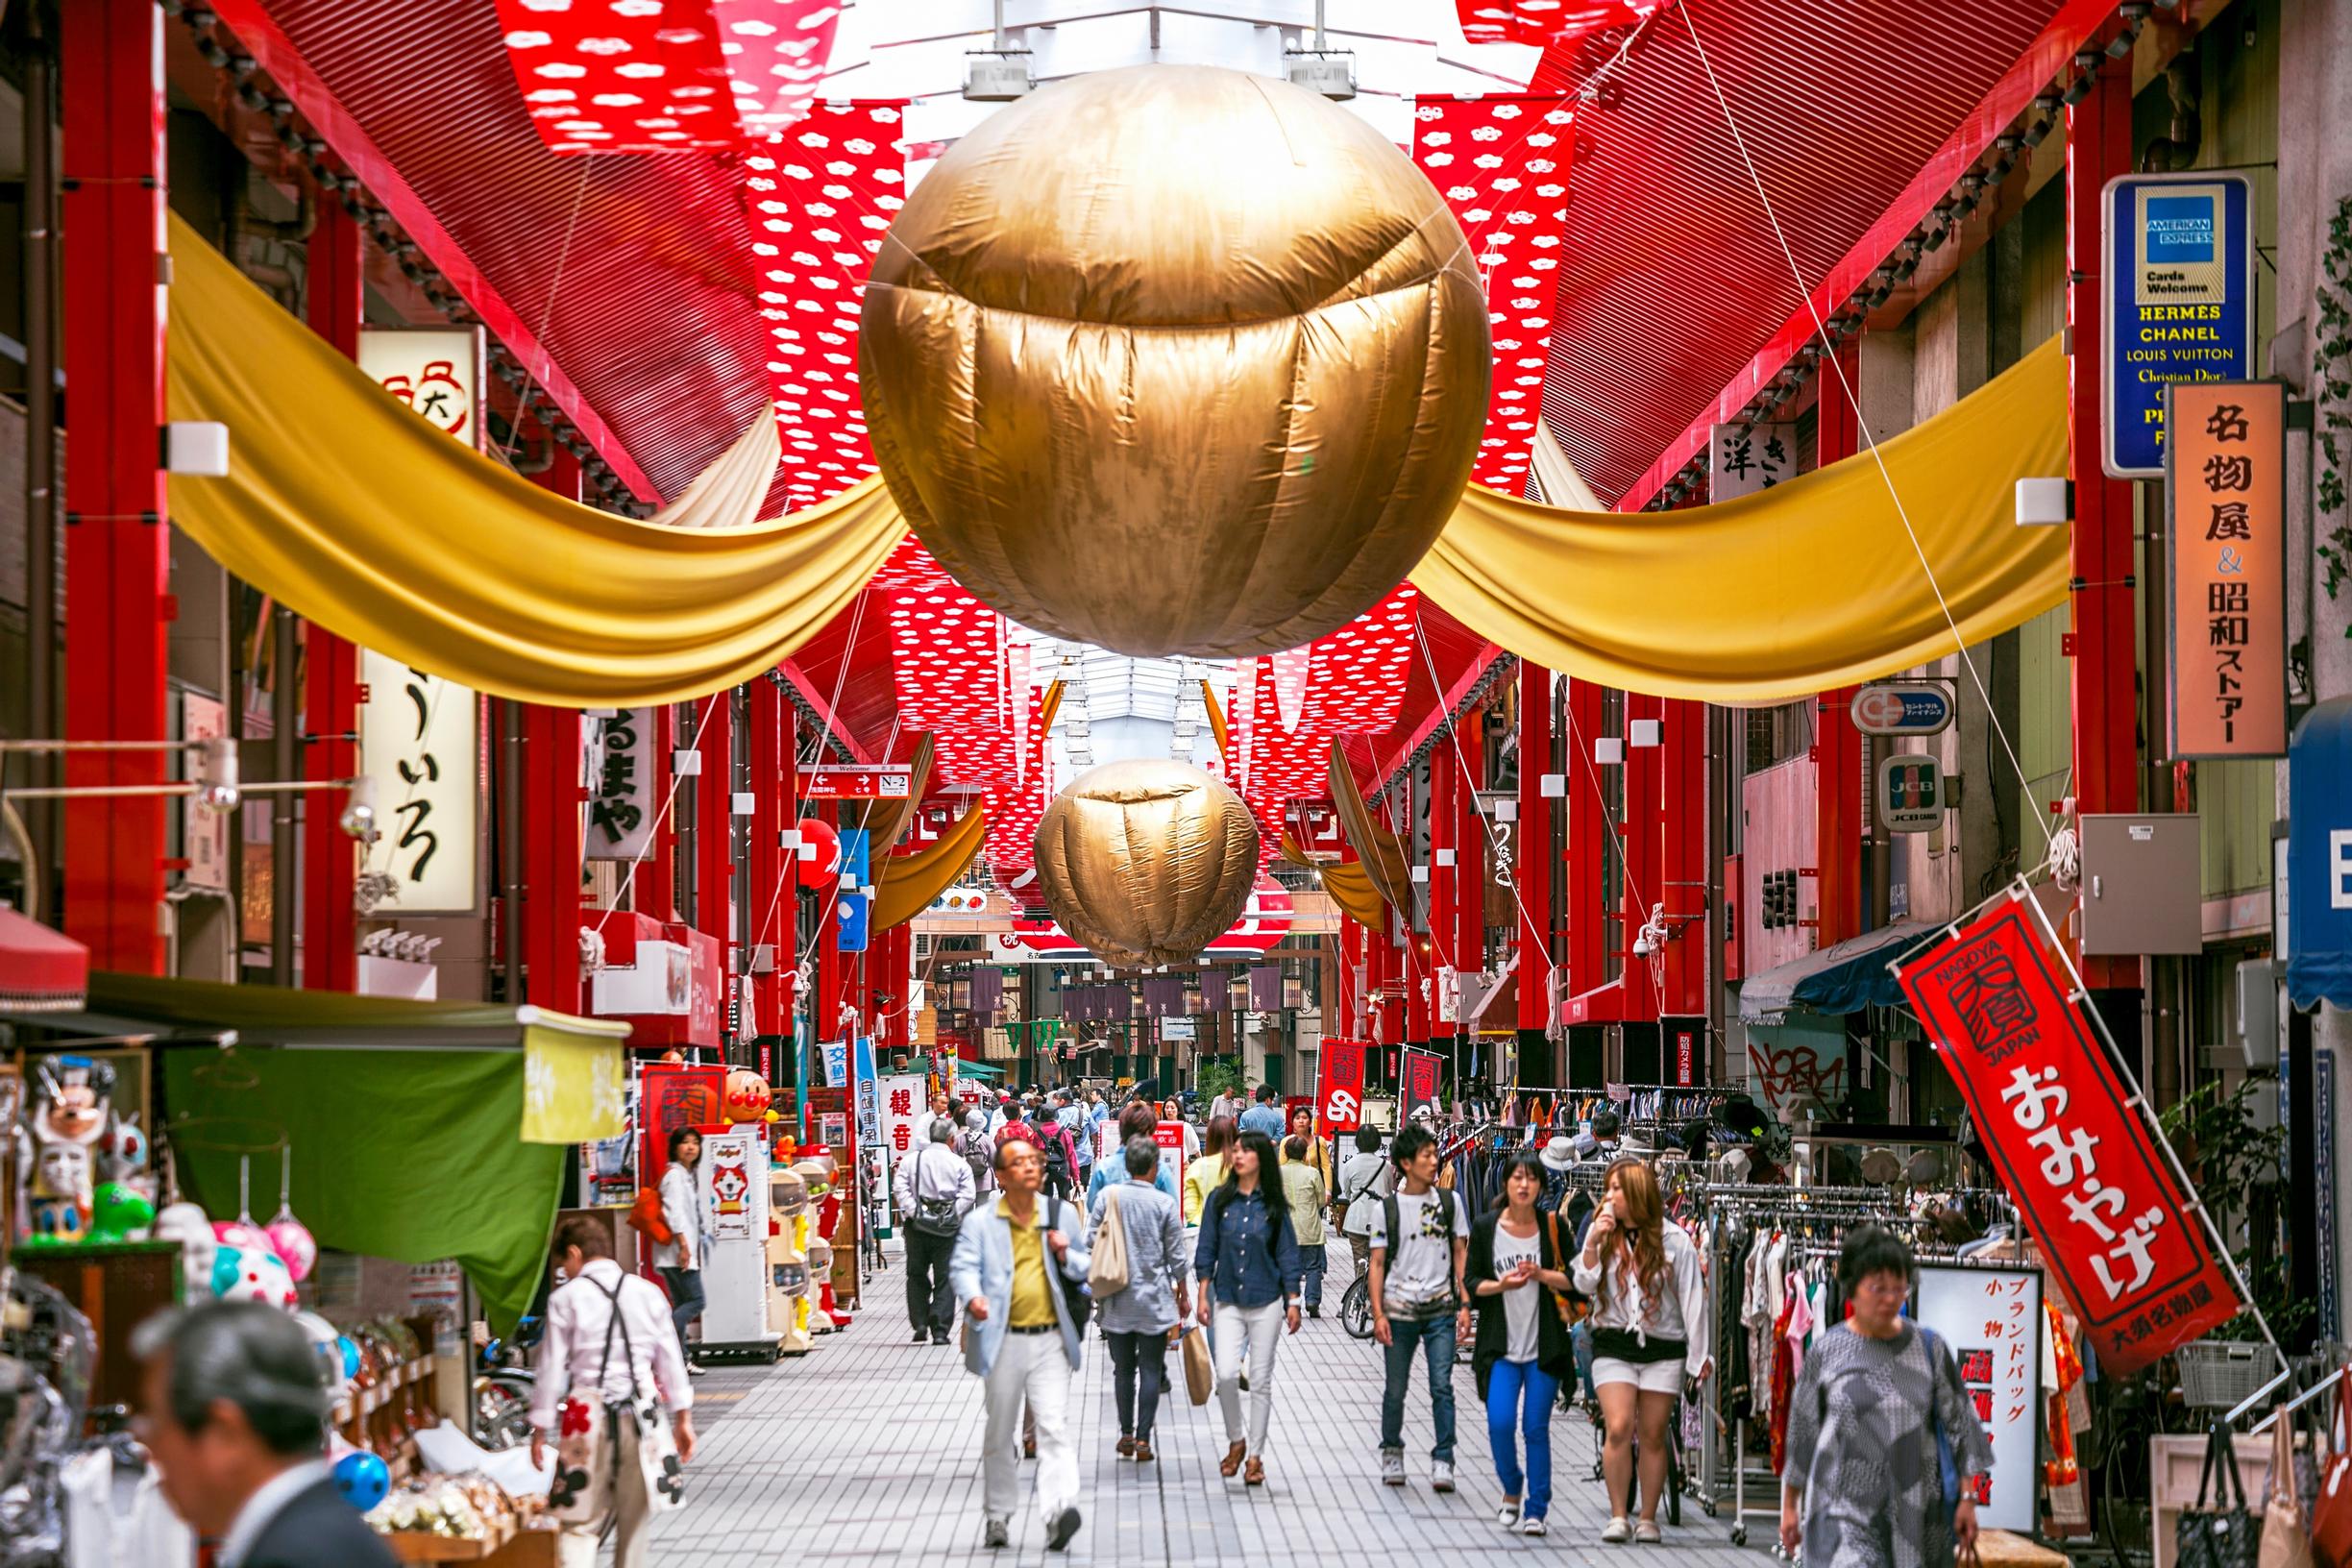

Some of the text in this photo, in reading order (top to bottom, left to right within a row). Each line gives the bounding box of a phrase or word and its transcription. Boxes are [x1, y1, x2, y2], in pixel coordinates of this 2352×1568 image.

[2147, 219, 2210, 232] AMERICAN
[2160, 232, 2214, 244] EXPRESS
[2147, 271, 2185, 282] Cards
[2147, 282, 2209, 293] Welcome
[2141, 329, 2219, 341] CHANEL
[2127, 348, 2234, 361] LOUIS VUITTON
[2138, 369, 2222, 382] Christian Dior
[1724, 438, 1756, 481] 洋
[395, 667, 439, 883] ういろ
[881, 776, 906, 787] N-2
[1891, 781, 1934, 793] JCB
[1890, 814, 1919, 822] JCB
[1933, 940, 2003, 986] NAGOYA
[1984, 1026, 2041, 1067] JAPAN
[2000, 1065, 2165, 1302] おみやげ
[1984, 1278, 2004, 1338] 小物
